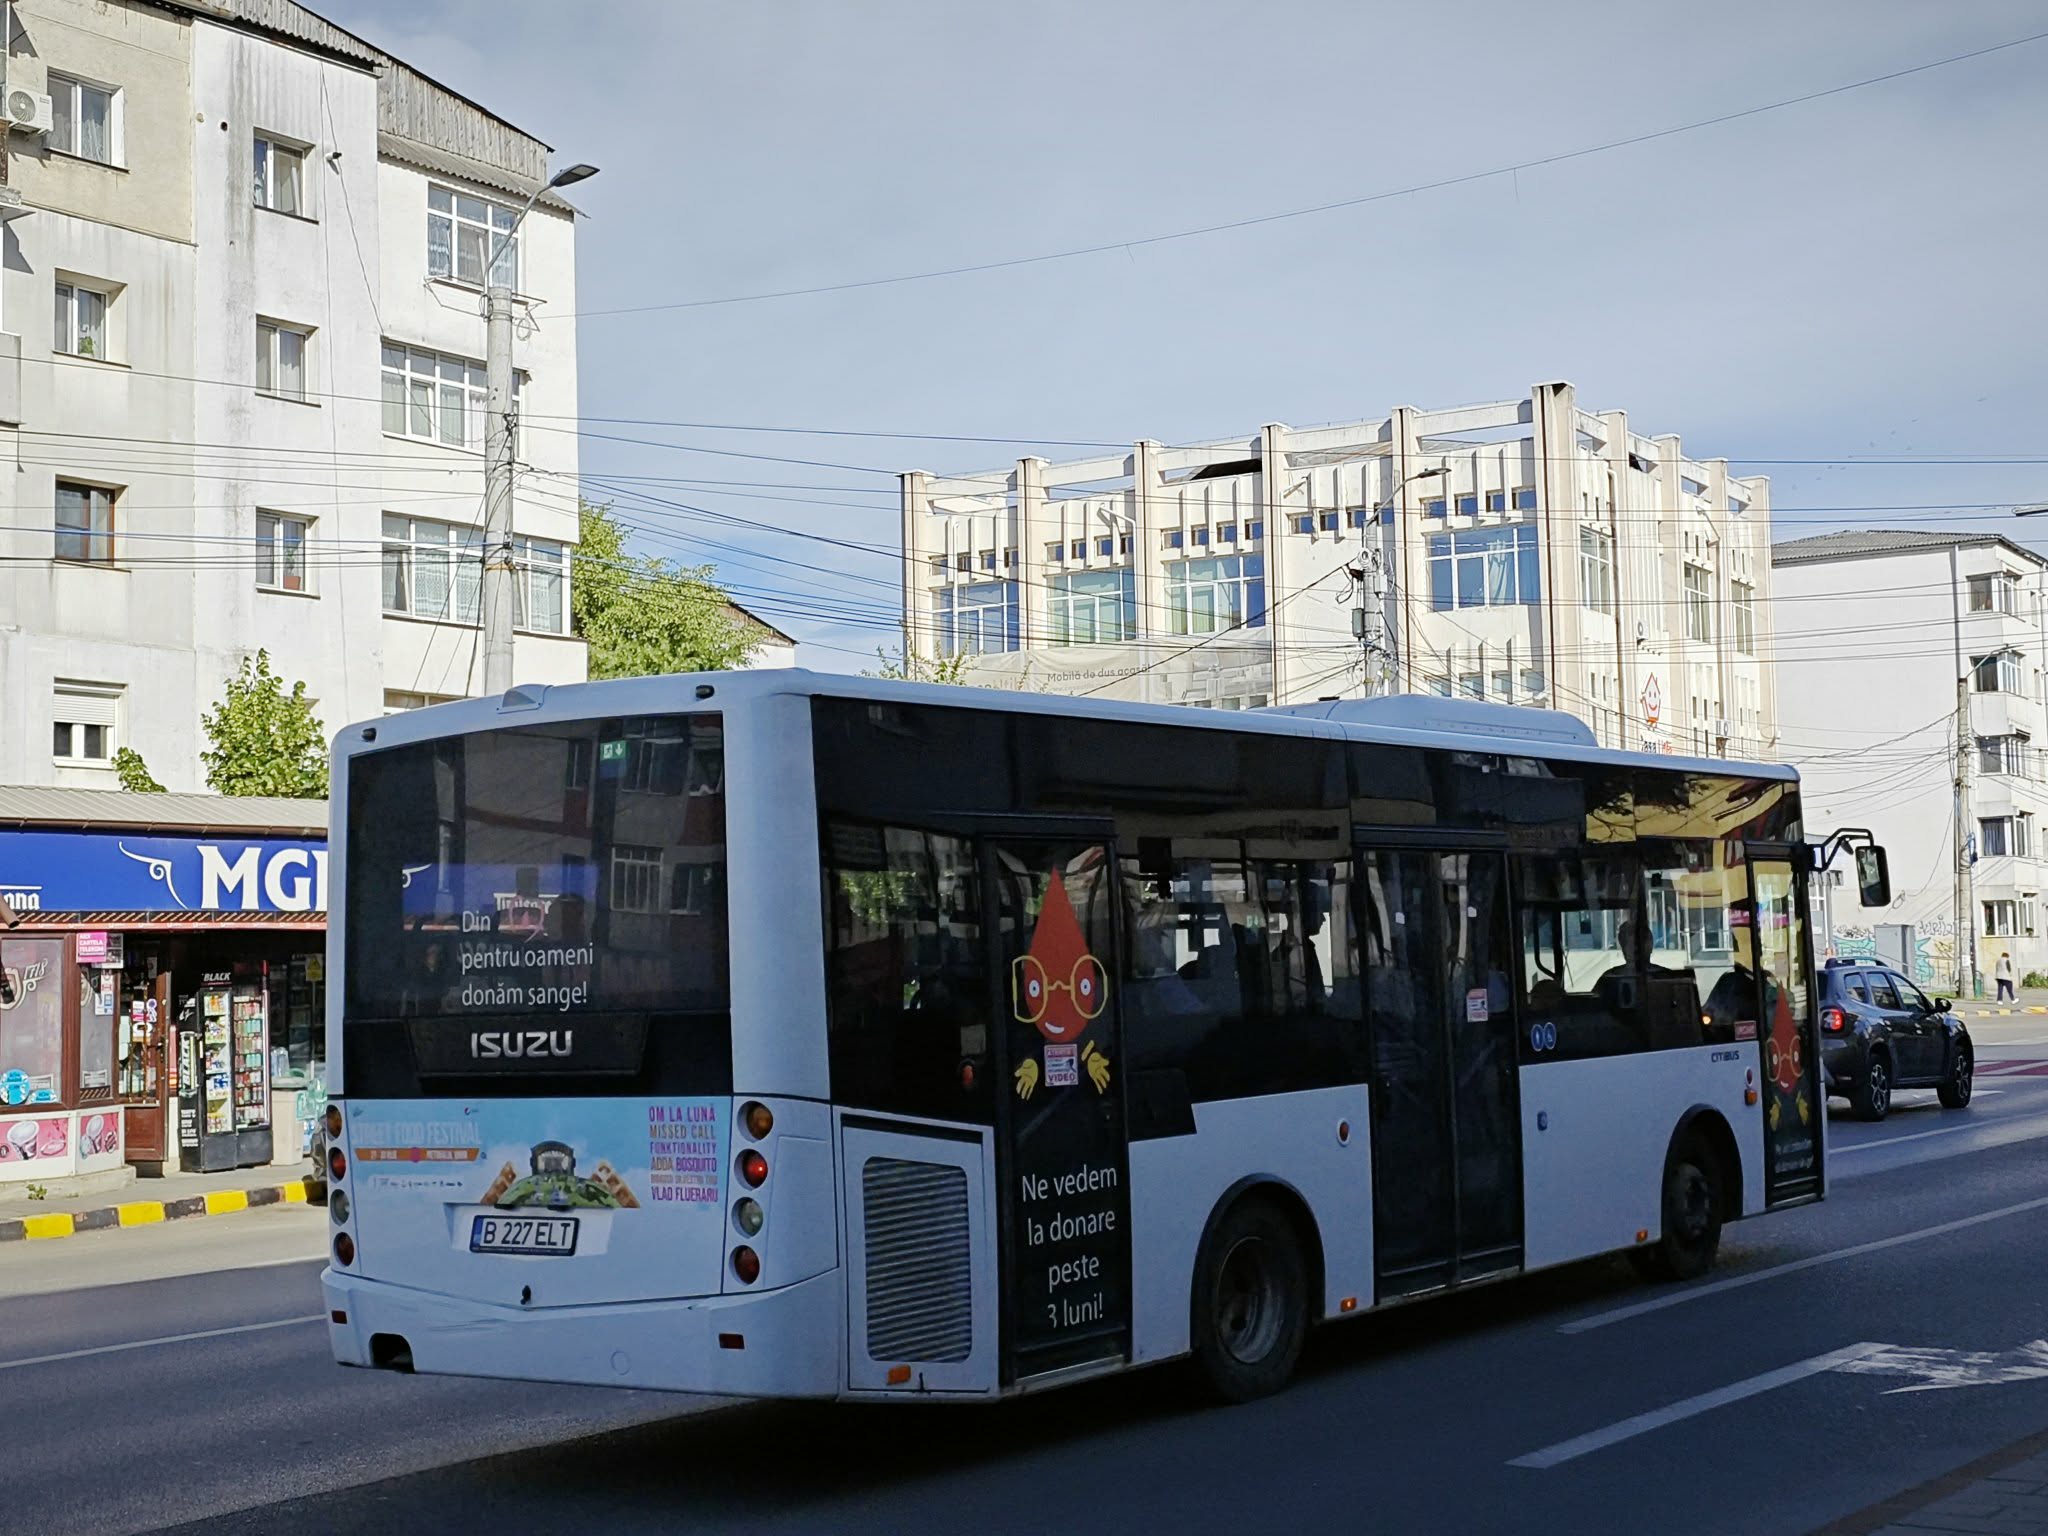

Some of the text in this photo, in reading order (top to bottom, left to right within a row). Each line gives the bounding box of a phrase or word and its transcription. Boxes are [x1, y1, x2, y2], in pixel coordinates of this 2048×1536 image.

[1047, 669, 1081, 683] Mobilă
[1083, 667, 1096, 680] de
[1097, 665, 1116, 678] dus
[462, 910, 491, 932] Din
[23, 957, 48, 980] 1718
[461, 942, 594, 975] pentru oameni
[203, 972, 232, 982] BLACK
[461, 981, 588, 1012] donăm sange!
[470, 1030, 573, 1058] ISUZU
[1711, 1050, 1740, 1063] CITIBUS
[1047, 1073, 1076, 1082] VIDEO
[649, 1106, 665, 1122] OM
[669, 1106, 682, 1122] LA
[427, 1120, 483, 1146] FESTIVAL
[649, 1124, 716, 1140] MISSED CALL
[649, 1141, 717, 1155] FUNKTIONALITY
[651, 1156, 673, 1172] ADDA
[651, 1186, 673, 1201] VLAD
[1022, 1164, 1117, 1202] Ne vedem
[483, 1221, 571, 1246] B 227 ELT
[1028, 1210, 1116, 1246] la donare
[1048, 1254, 1100, 1293] peste
[1047, 1291, 1103, 1329] 3 luni!
